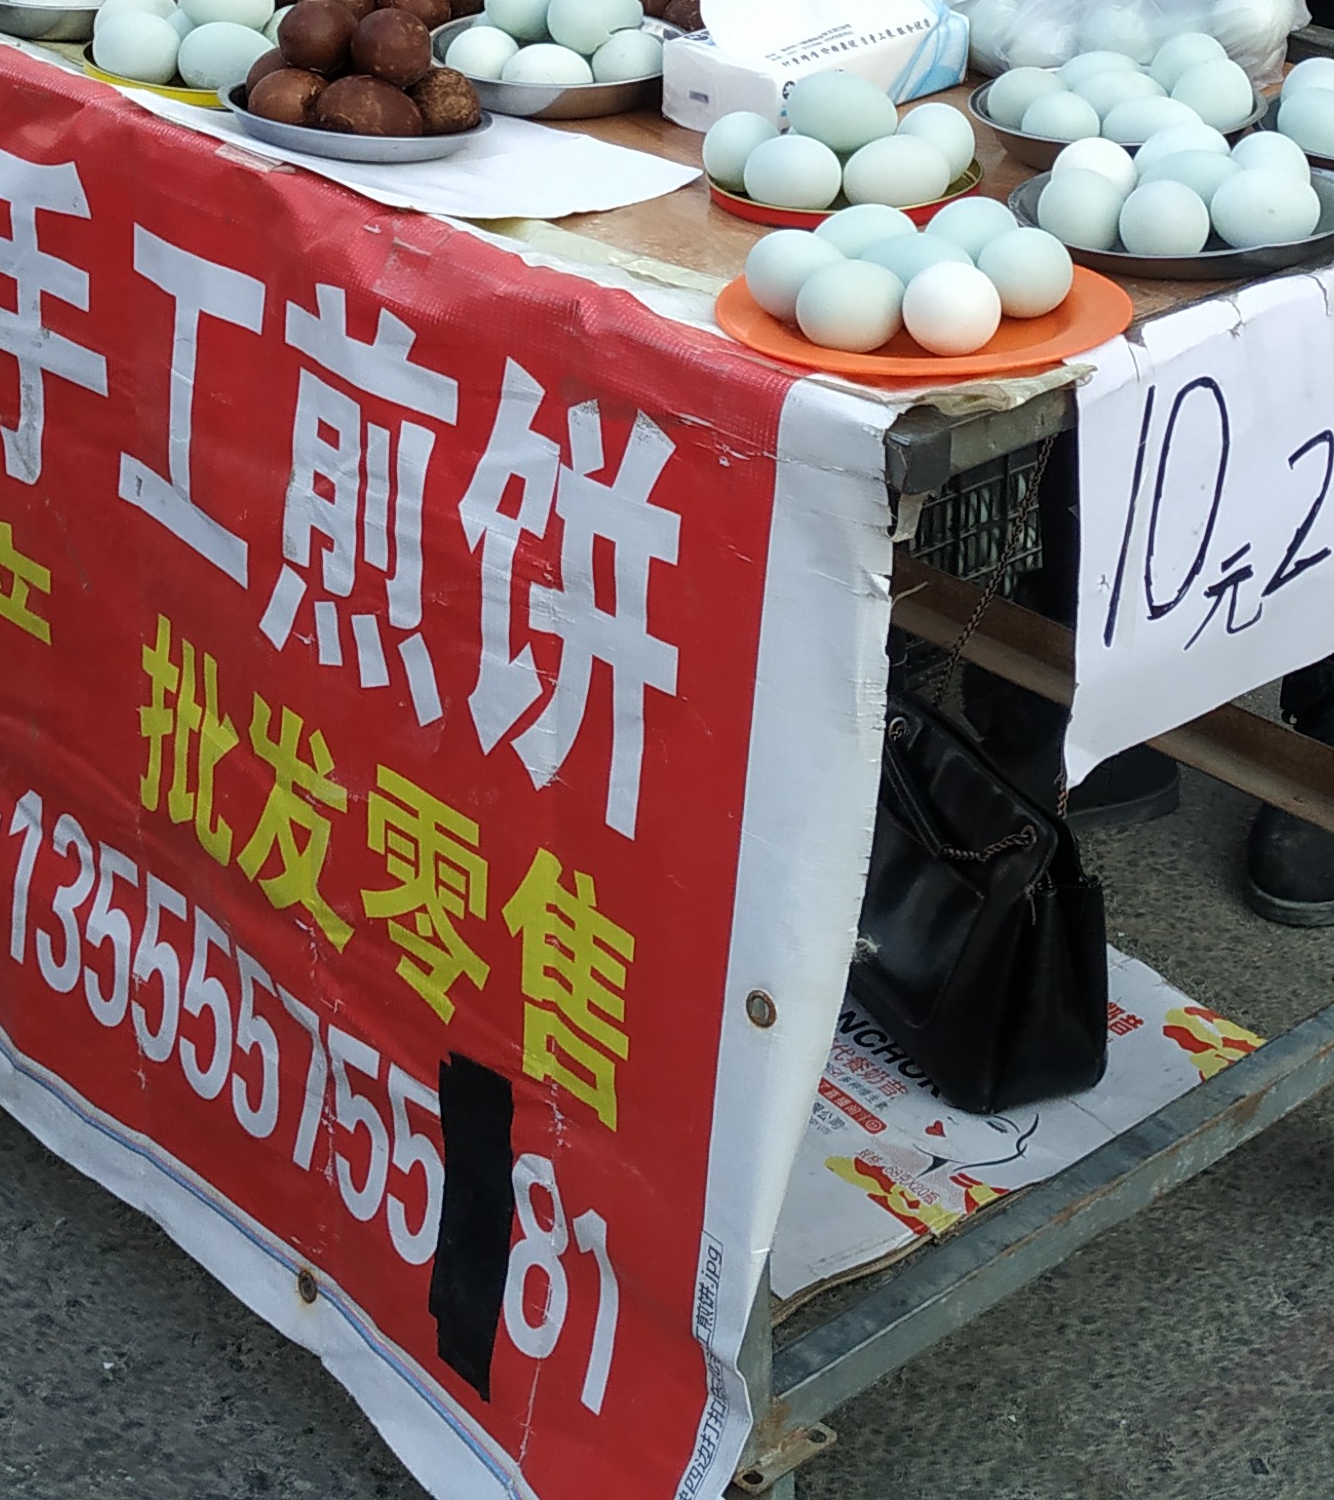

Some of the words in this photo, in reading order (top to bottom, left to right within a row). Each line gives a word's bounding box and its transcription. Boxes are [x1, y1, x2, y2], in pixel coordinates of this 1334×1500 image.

[138, 616, 636, 1132] 批发零售
[832, 1037, 908, 1099] 代餐奶昔
